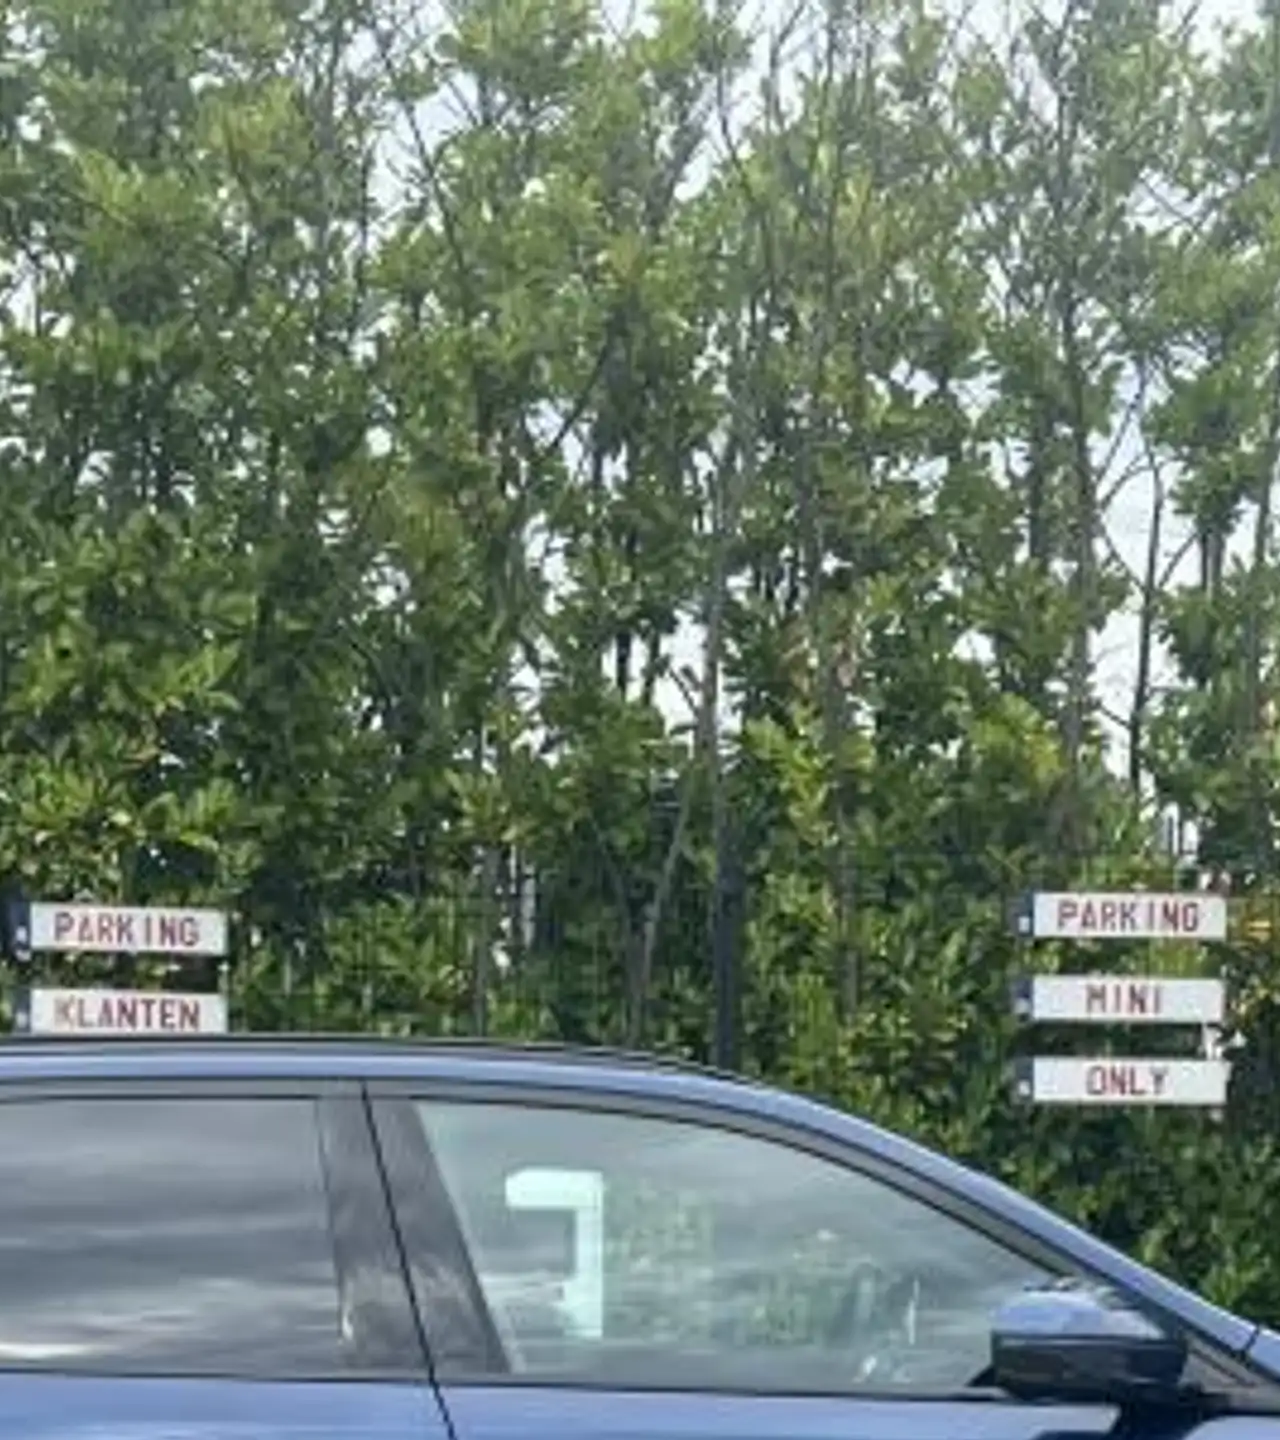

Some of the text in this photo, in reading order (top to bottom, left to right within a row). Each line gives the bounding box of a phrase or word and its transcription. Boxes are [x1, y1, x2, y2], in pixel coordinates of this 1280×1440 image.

[53, 912, 200, 947] PARKING
[1057, 900, 1201, 934] PARKING
[54, 997, 200, 1031] KLANTEN
[1085, 984, 1163, 1015] MINI
[1086, 1065, 1168, 1096] ONLY
